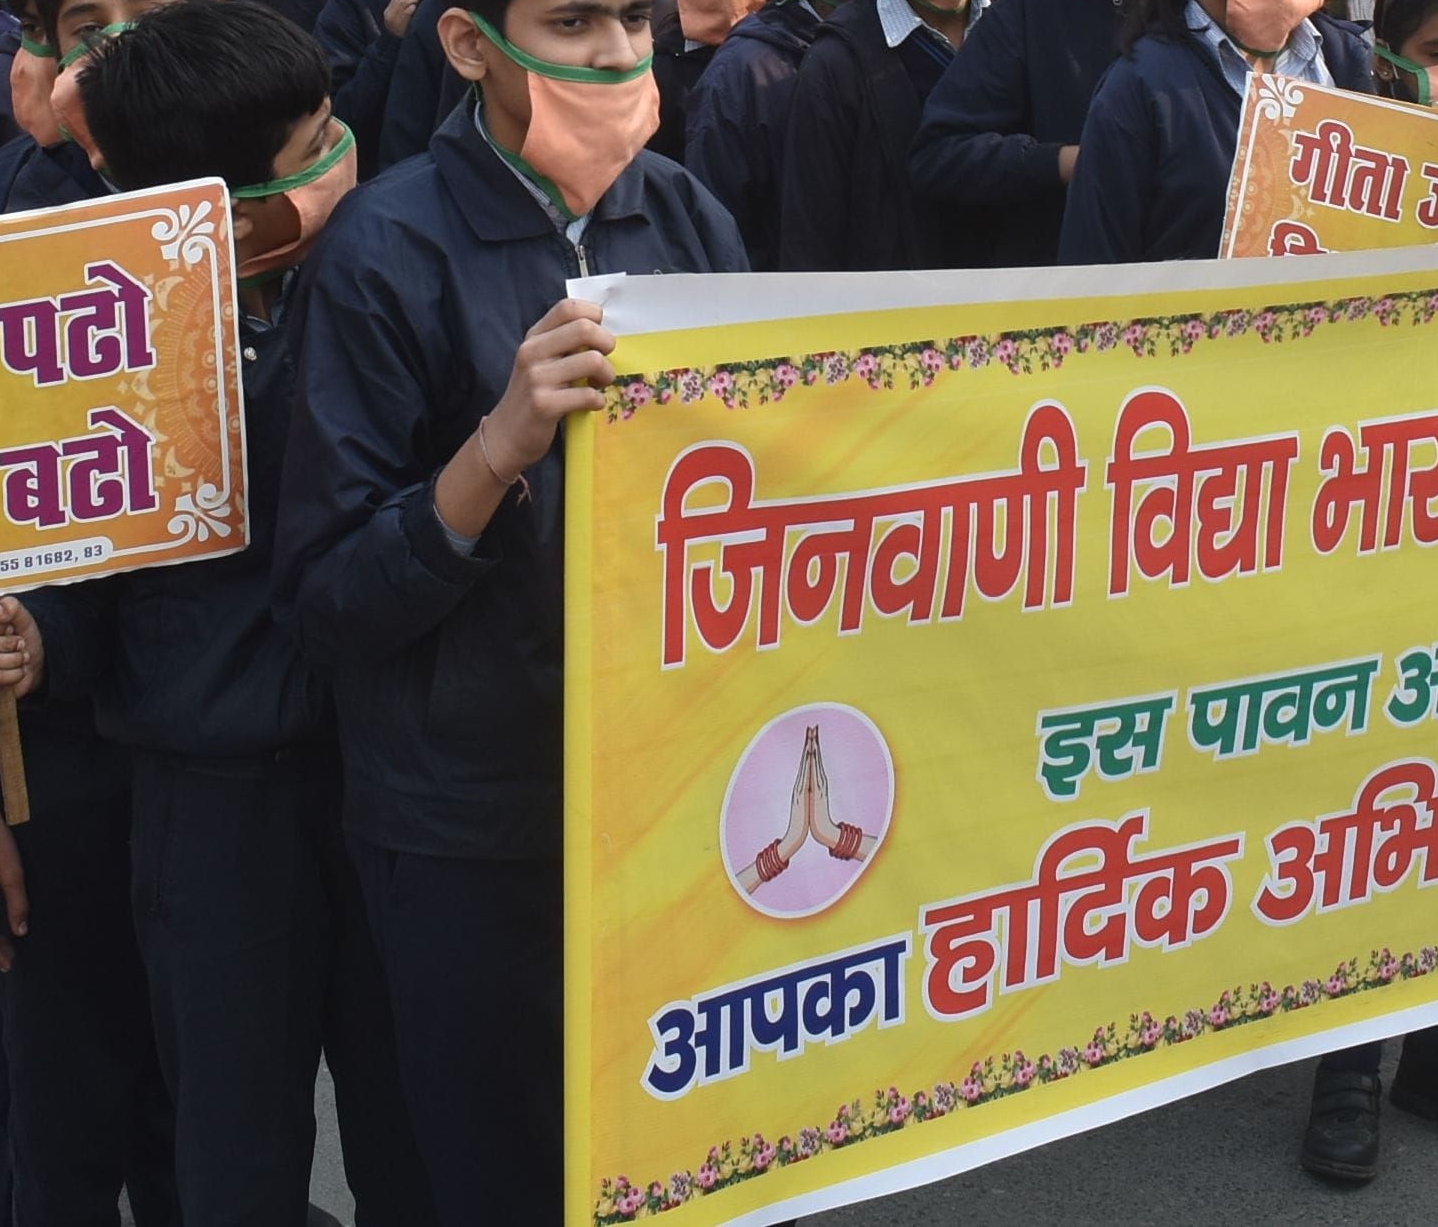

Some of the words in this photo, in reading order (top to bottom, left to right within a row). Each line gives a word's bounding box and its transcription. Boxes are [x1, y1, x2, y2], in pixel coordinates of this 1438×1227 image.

[1289, 118, 1410, 223] गीता
[23, 549, 82, 570] 81682,
[83, 544, 104, 560] 83
[655, 400, 1086, 670] जिनवाणी
[1104, 386, 1299, 599] विद्या
[1035, 690, 1172, 801] इस
[1189, 654, 1382, 766] पावन
[644, 937, 910, 1101] आपका
[917, 809, 1246, 1023] हार्दिक
